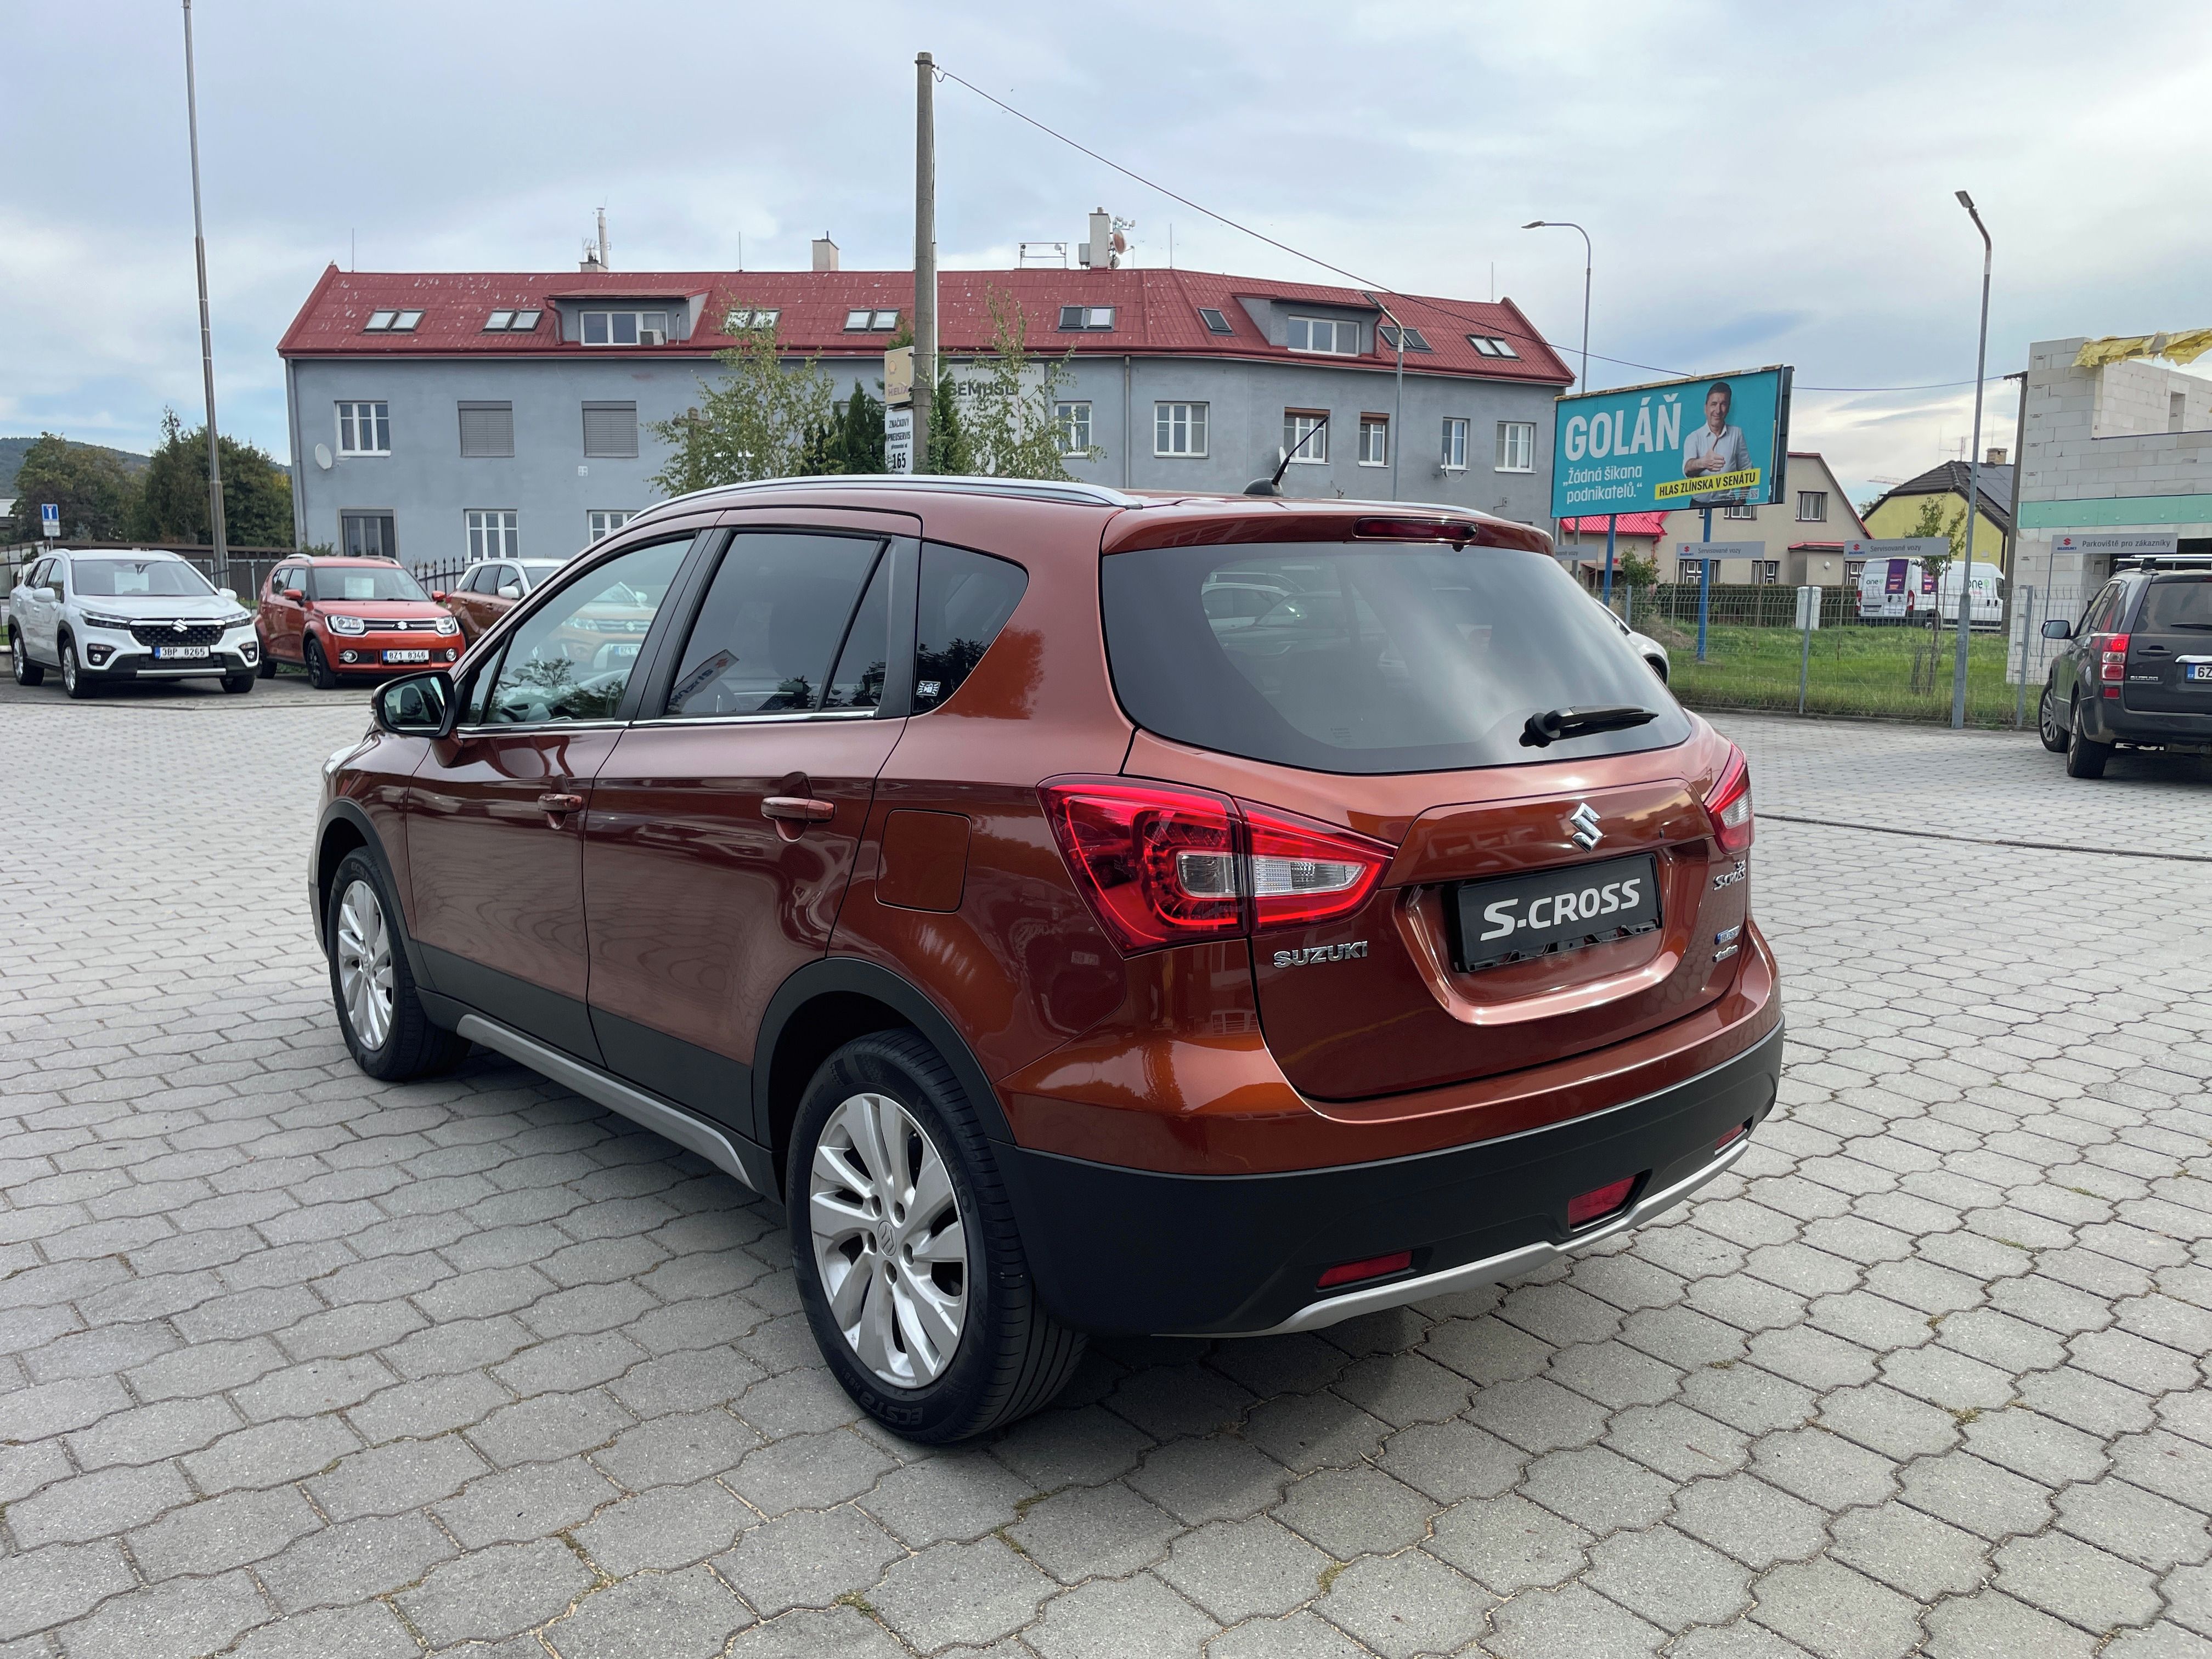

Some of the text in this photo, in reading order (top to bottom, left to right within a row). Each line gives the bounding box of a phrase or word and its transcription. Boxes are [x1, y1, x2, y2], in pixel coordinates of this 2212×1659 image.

[1565, 392, 1682, 461] GOLÁŇ
[893, 453, 906, 469] 165
[1604, 466, 1643, 481] šikana
[1659, 472, 1756, 496] HLAS ZLÍNSKA V SENÁTU
[2082, 539, 2119, 548] Parkoviště
[2135, 539, 2171, 548] zákazníky
[1273, 940, 1369, 969] SUZUKI
